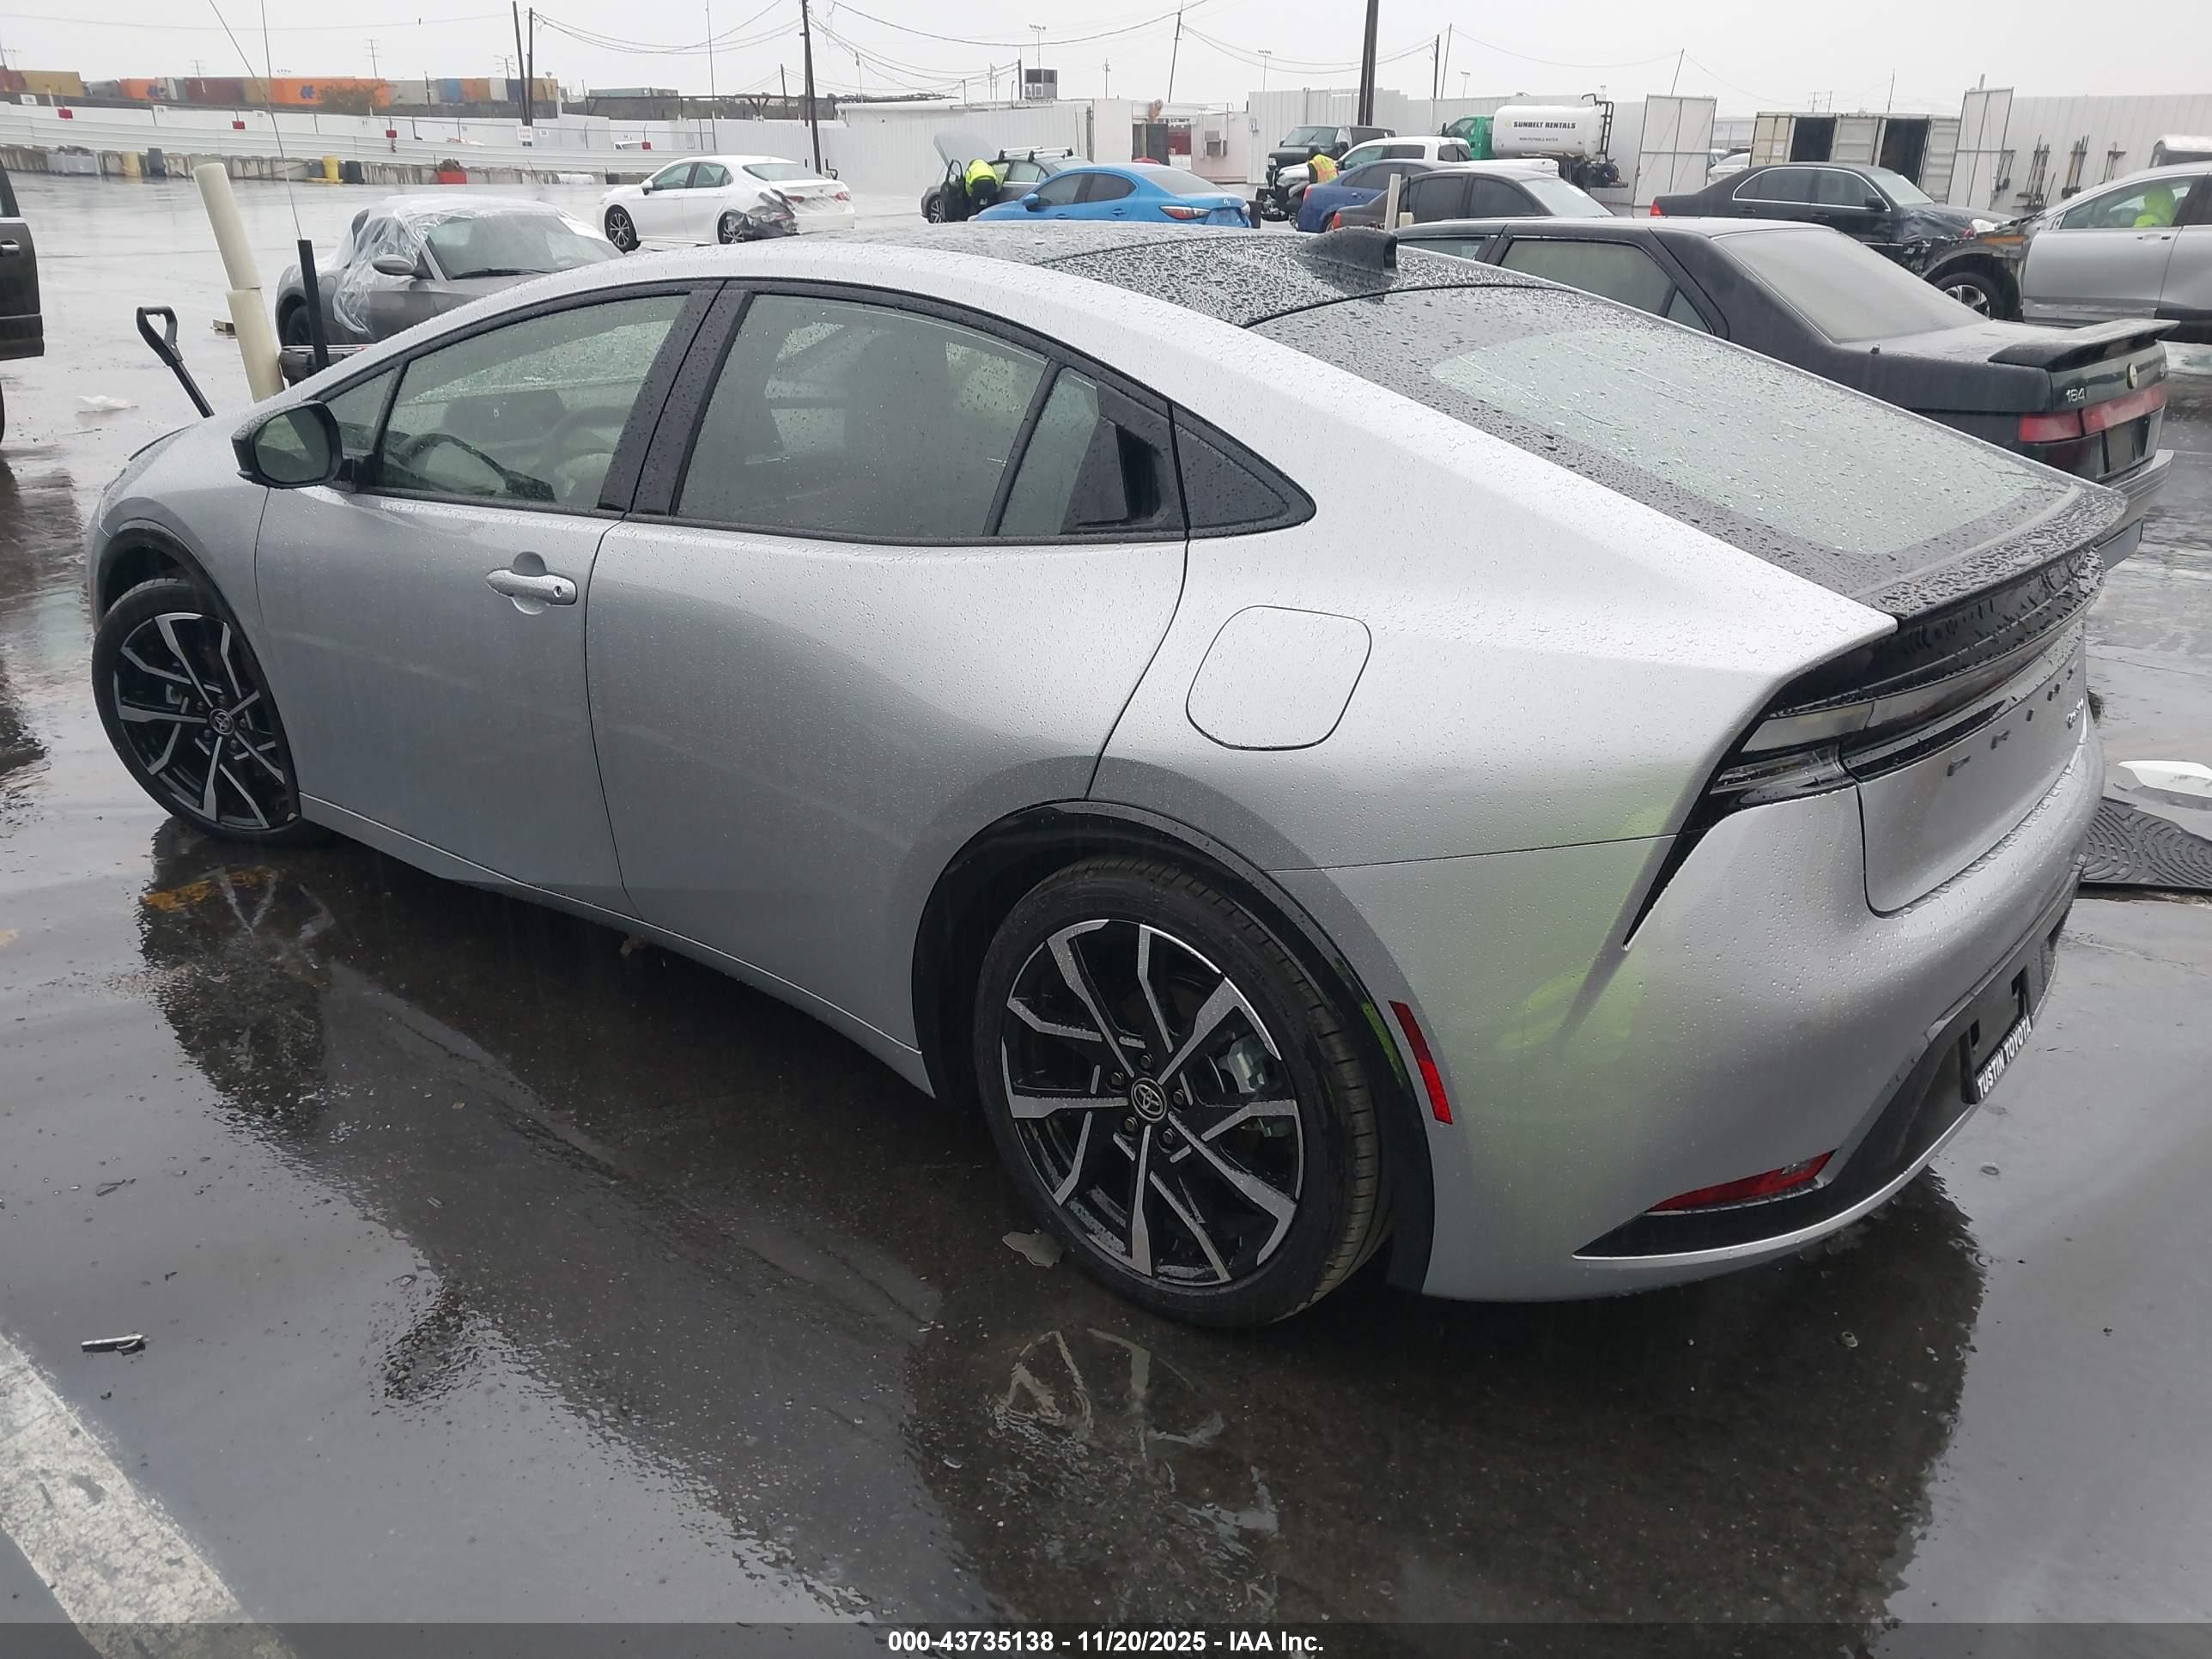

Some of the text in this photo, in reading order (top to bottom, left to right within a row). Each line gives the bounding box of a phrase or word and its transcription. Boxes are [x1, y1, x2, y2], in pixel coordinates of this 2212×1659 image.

[1545, 121, 1577, 130] RENTALS
[2066, 387, 2087, 403] 164
[1978, 1015, 2033, 1099] TUSTIN TOYOTA
